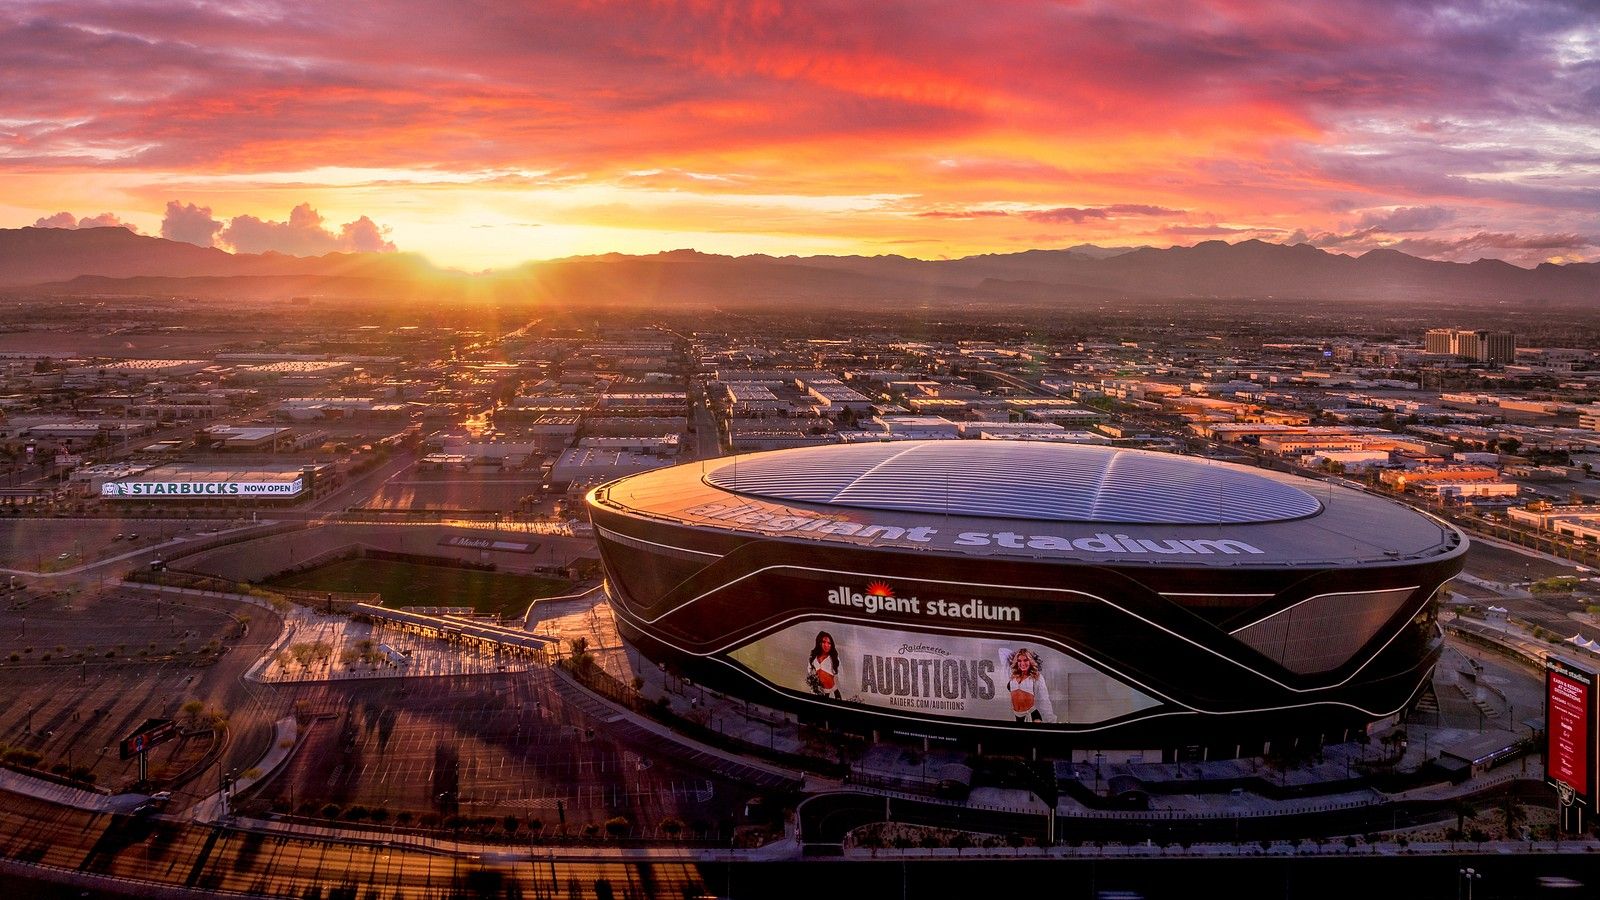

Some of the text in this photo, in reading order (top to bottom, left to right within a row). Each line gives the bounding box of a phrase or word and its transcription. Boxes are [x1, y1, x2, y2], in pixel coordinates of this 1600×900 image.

[133, 483, 239, 494] STARBUCKS
[458, 537, 489, 548] Modelo
[954, 531, 1265, 554] stadium
[828, 586, 1021, 622] allegiant stadium
[862, 654, 996, 701] AUDITIONS
[889, 696, 965, 711] RAIDERS.COM/AUDITIONS
